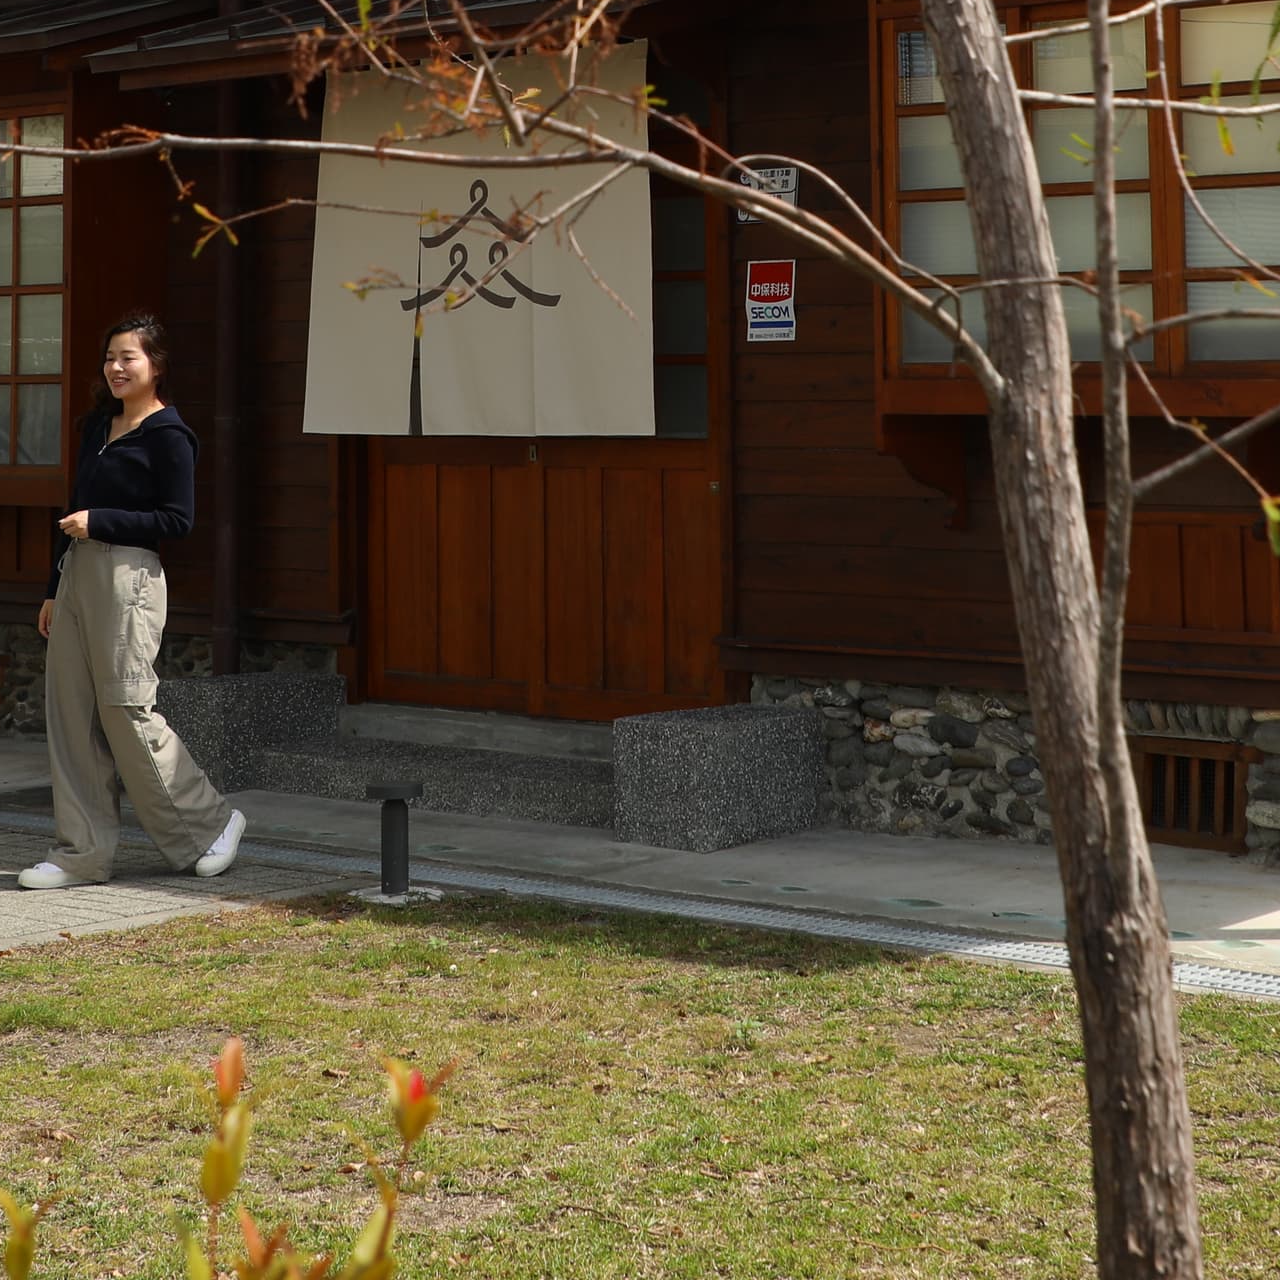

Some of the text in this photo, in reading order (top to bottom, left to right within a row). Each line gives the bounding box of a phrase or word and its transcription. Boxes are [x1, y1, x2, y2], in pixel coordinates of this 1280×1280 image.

[751, 282, 790, 297] 中保科技
[751, 306, 790, 319] SECOM
